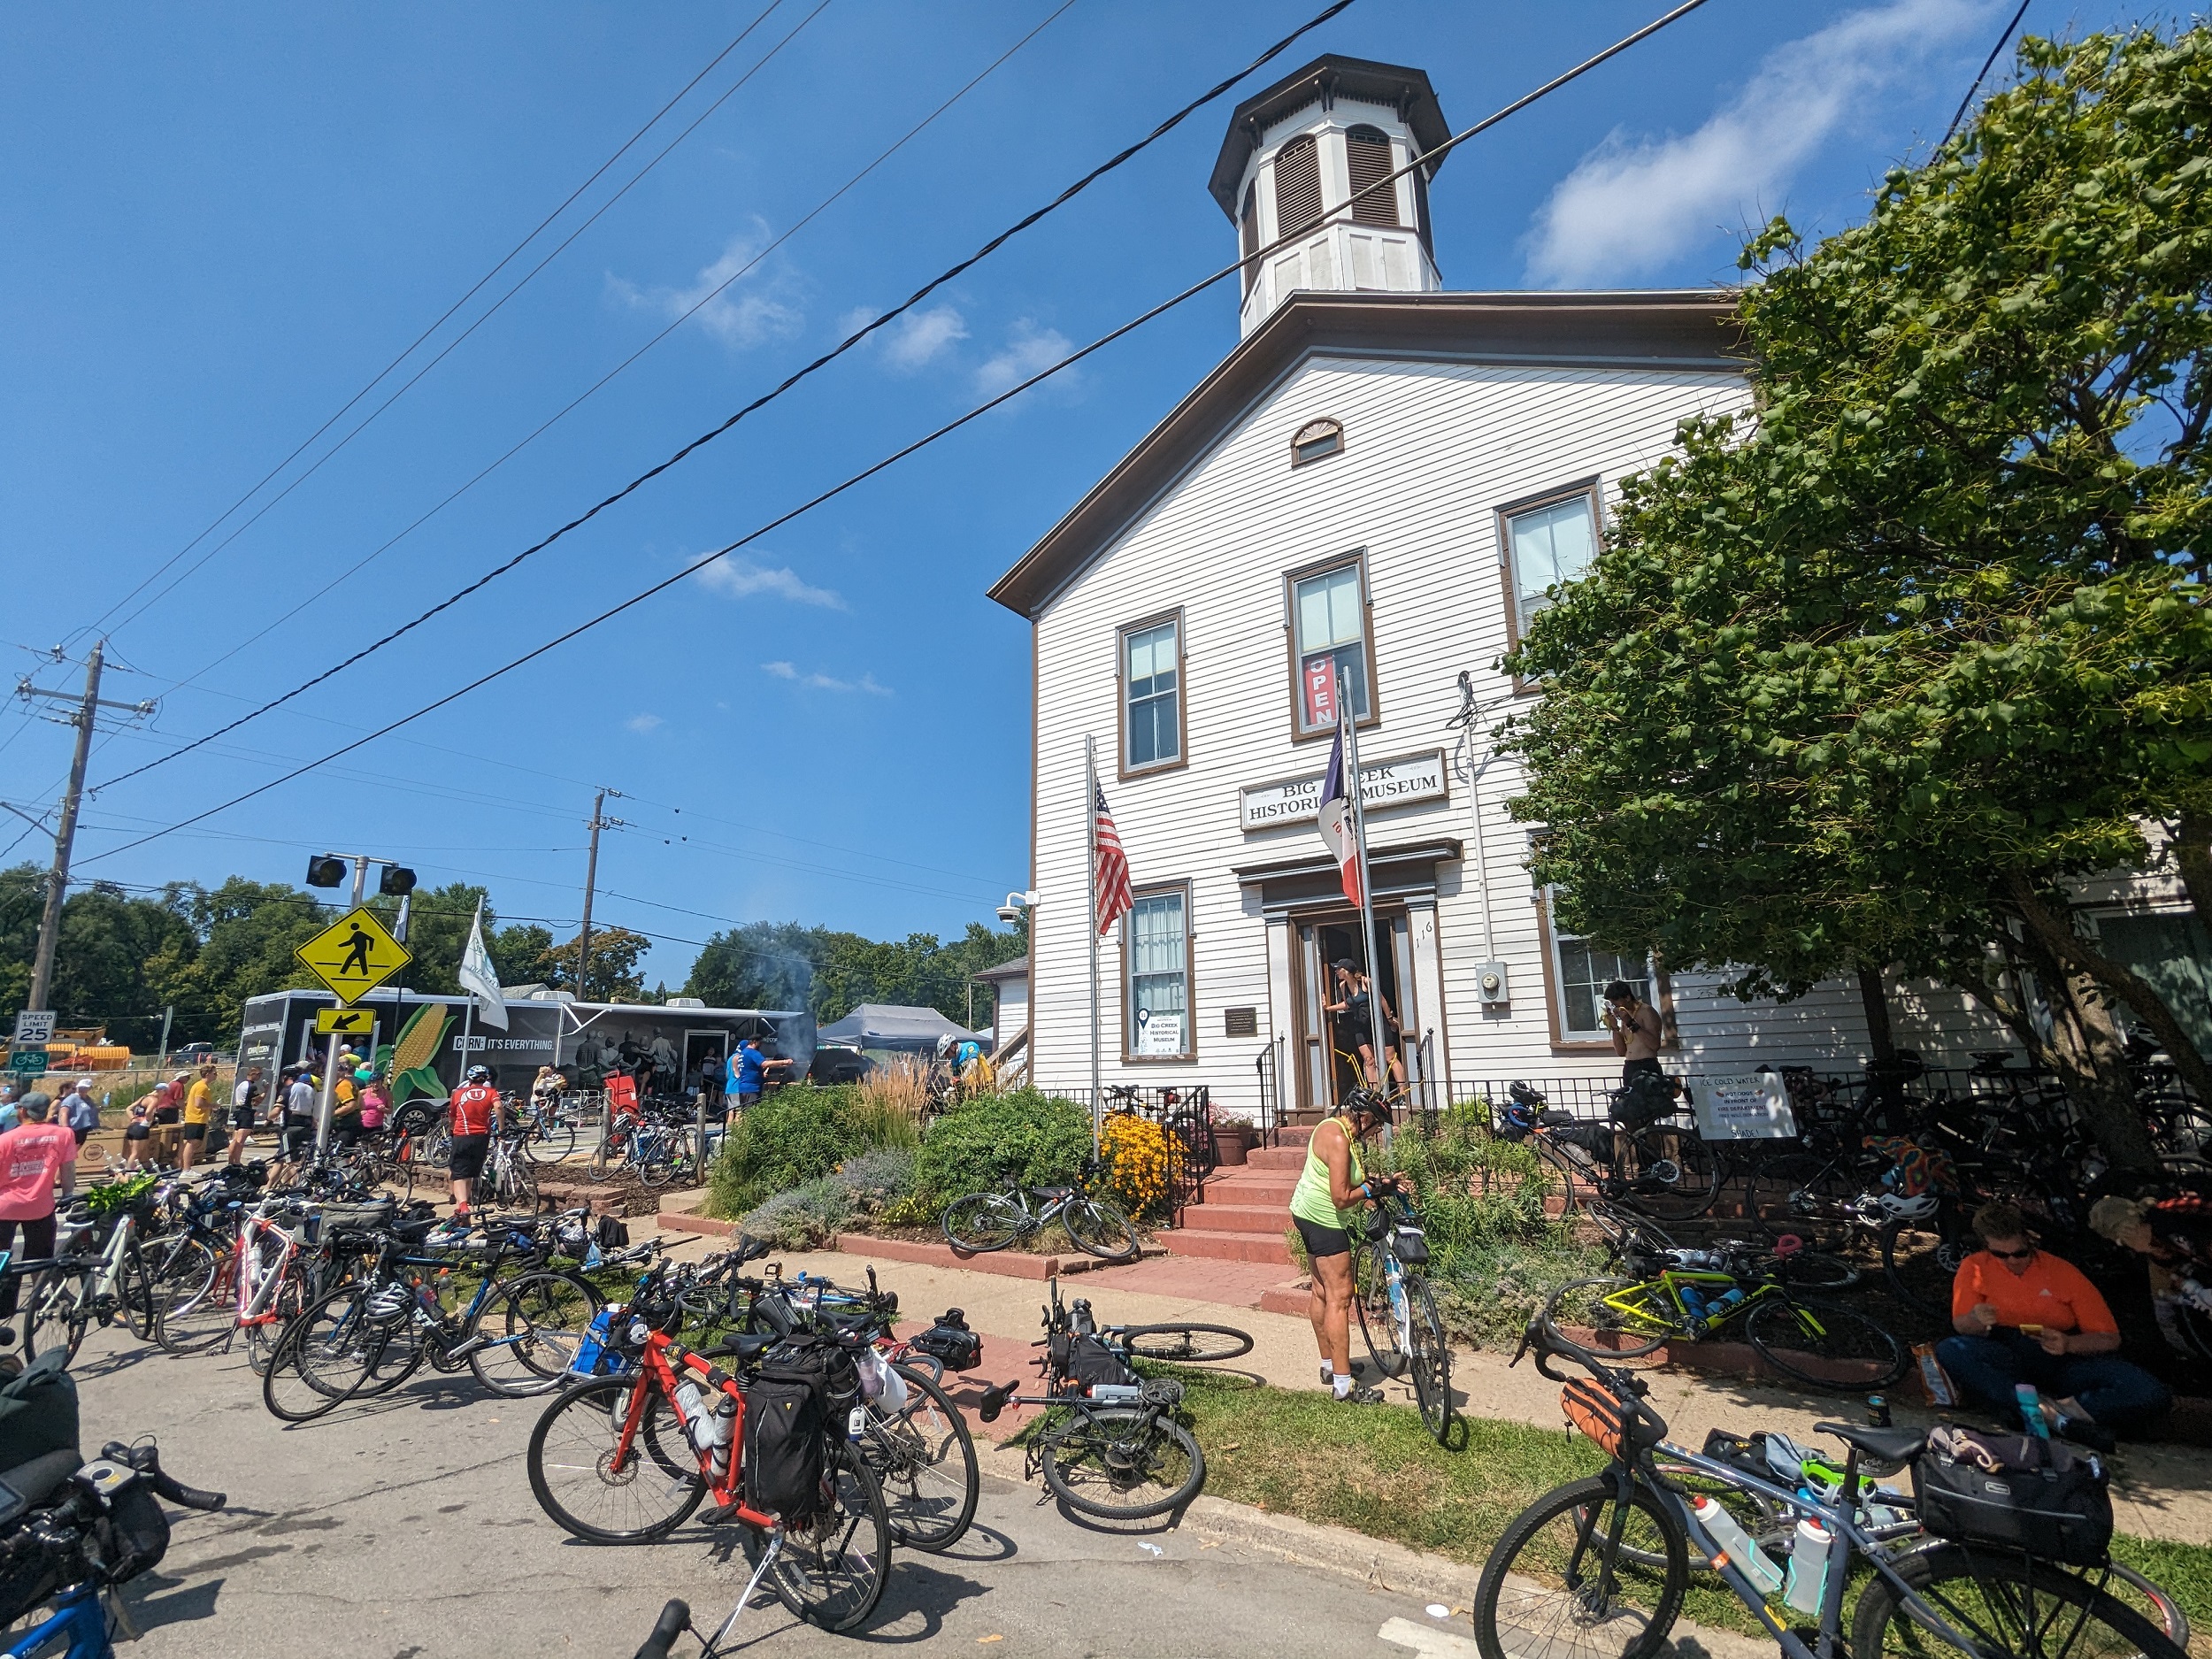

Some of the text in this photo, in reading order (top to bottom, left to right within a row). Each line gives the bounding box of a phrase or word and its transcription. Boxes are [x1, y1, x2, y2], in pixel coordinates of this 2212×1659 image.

[1310, 659, 1333, 725] OPEN
[1282, 766, 1395, 798] BIG EEK
[1249, 774, 1438, 820] HISTORI MUSEUM
[1416, 921, 1432, 949] 116
[19, 1028, 49, 1041] 25
[457, 1038, 554, 1050] CRN: IT'S EVERYTHING.
[1732, 1129, 1759, 1138] SHADE!
